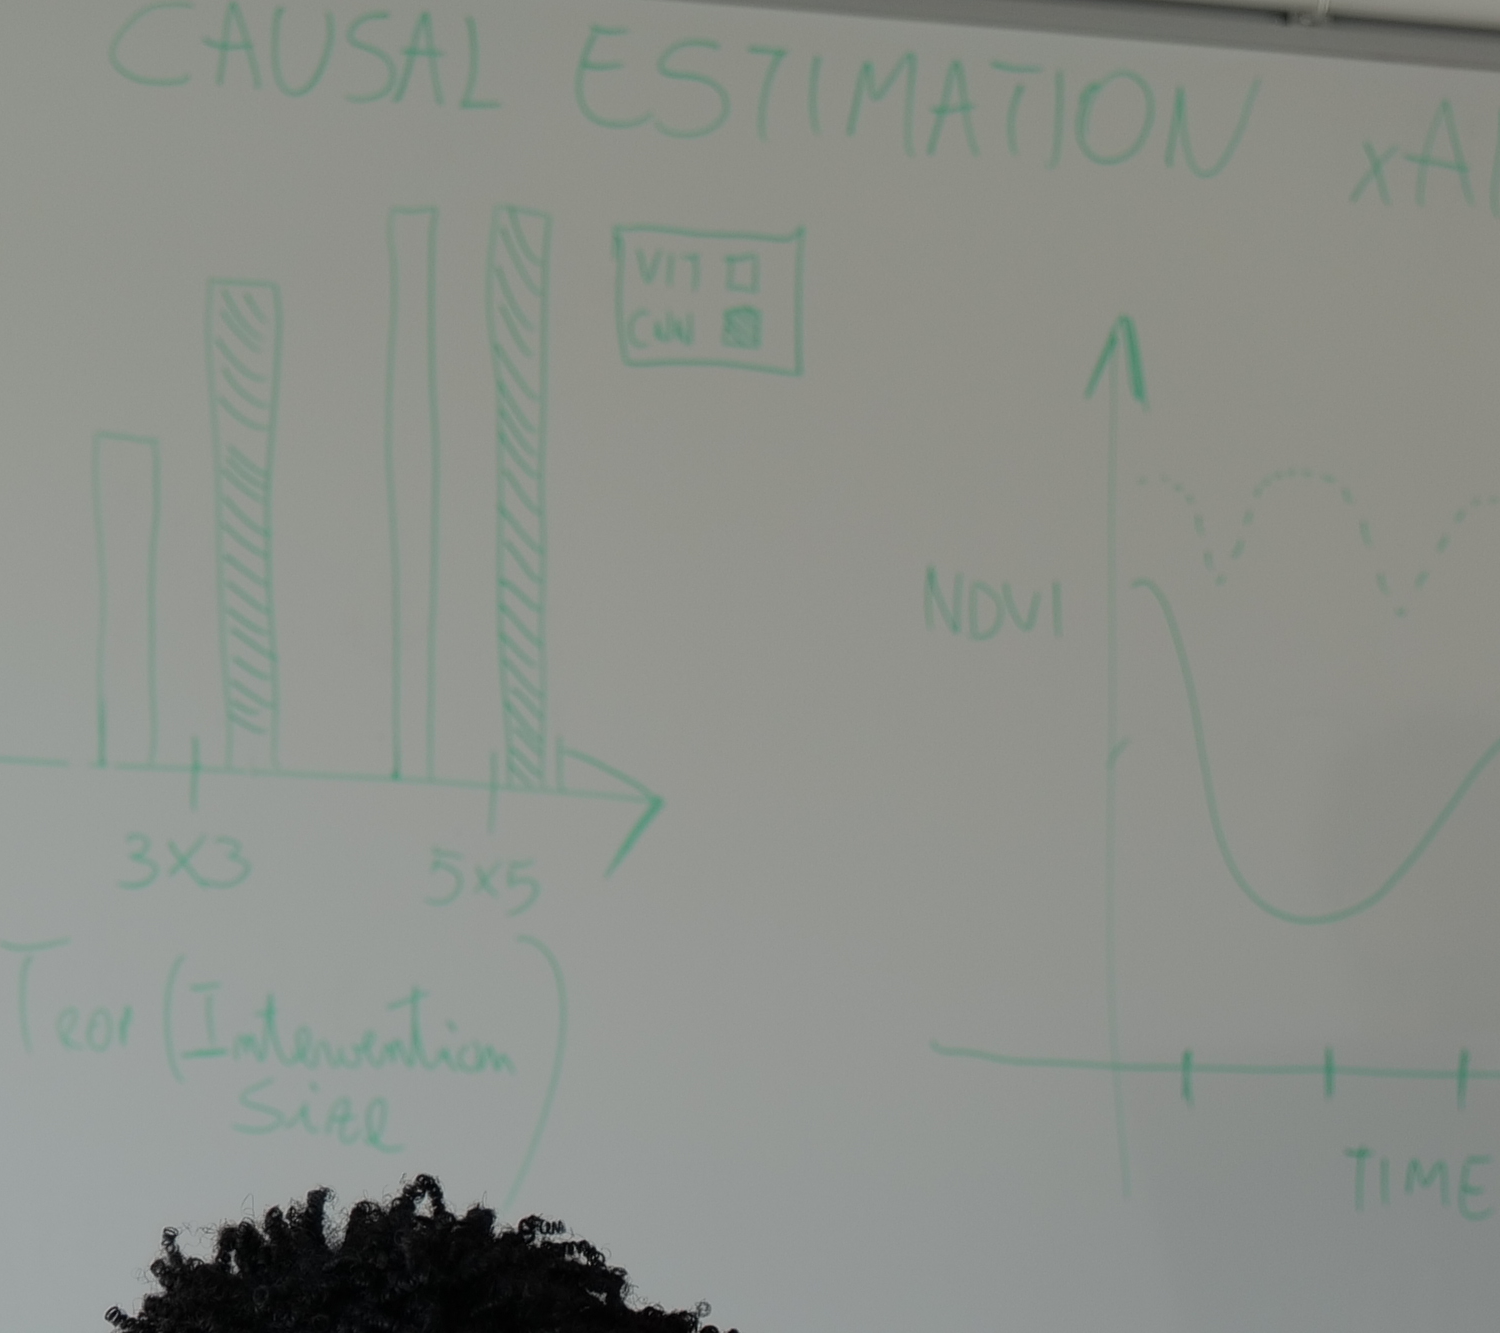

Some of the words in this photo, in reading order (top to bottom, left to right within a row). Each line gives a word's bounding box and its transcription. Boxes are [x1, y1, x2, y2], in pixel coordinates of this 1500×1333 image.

[107, 1, 501, 111] CAUSAL
[572, 24, 1263, 180] ESTIMATION
[922, 563, 1064, 642] NDVI
[1343, 1145, 1495, 1223] TIME
